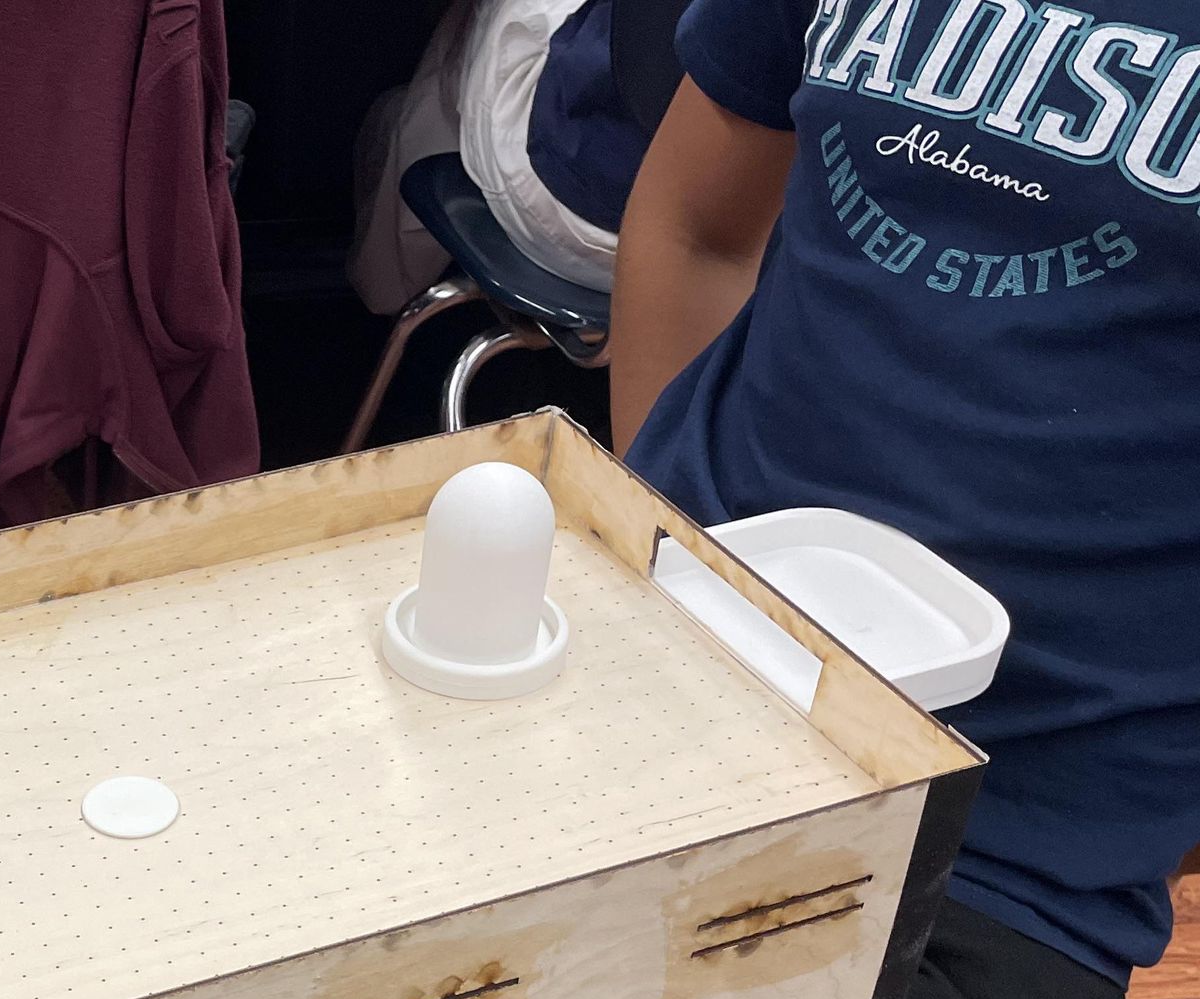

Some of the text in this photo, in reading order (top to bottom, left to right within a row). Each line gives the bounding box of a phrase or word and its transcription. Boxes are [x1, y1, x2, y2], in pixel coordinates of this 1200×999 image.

[804, 0, 1200, 204] ADISO
[875, 122, 1051, 202] Alabama
[820, 121, 1139, 298] UNITED STATES
